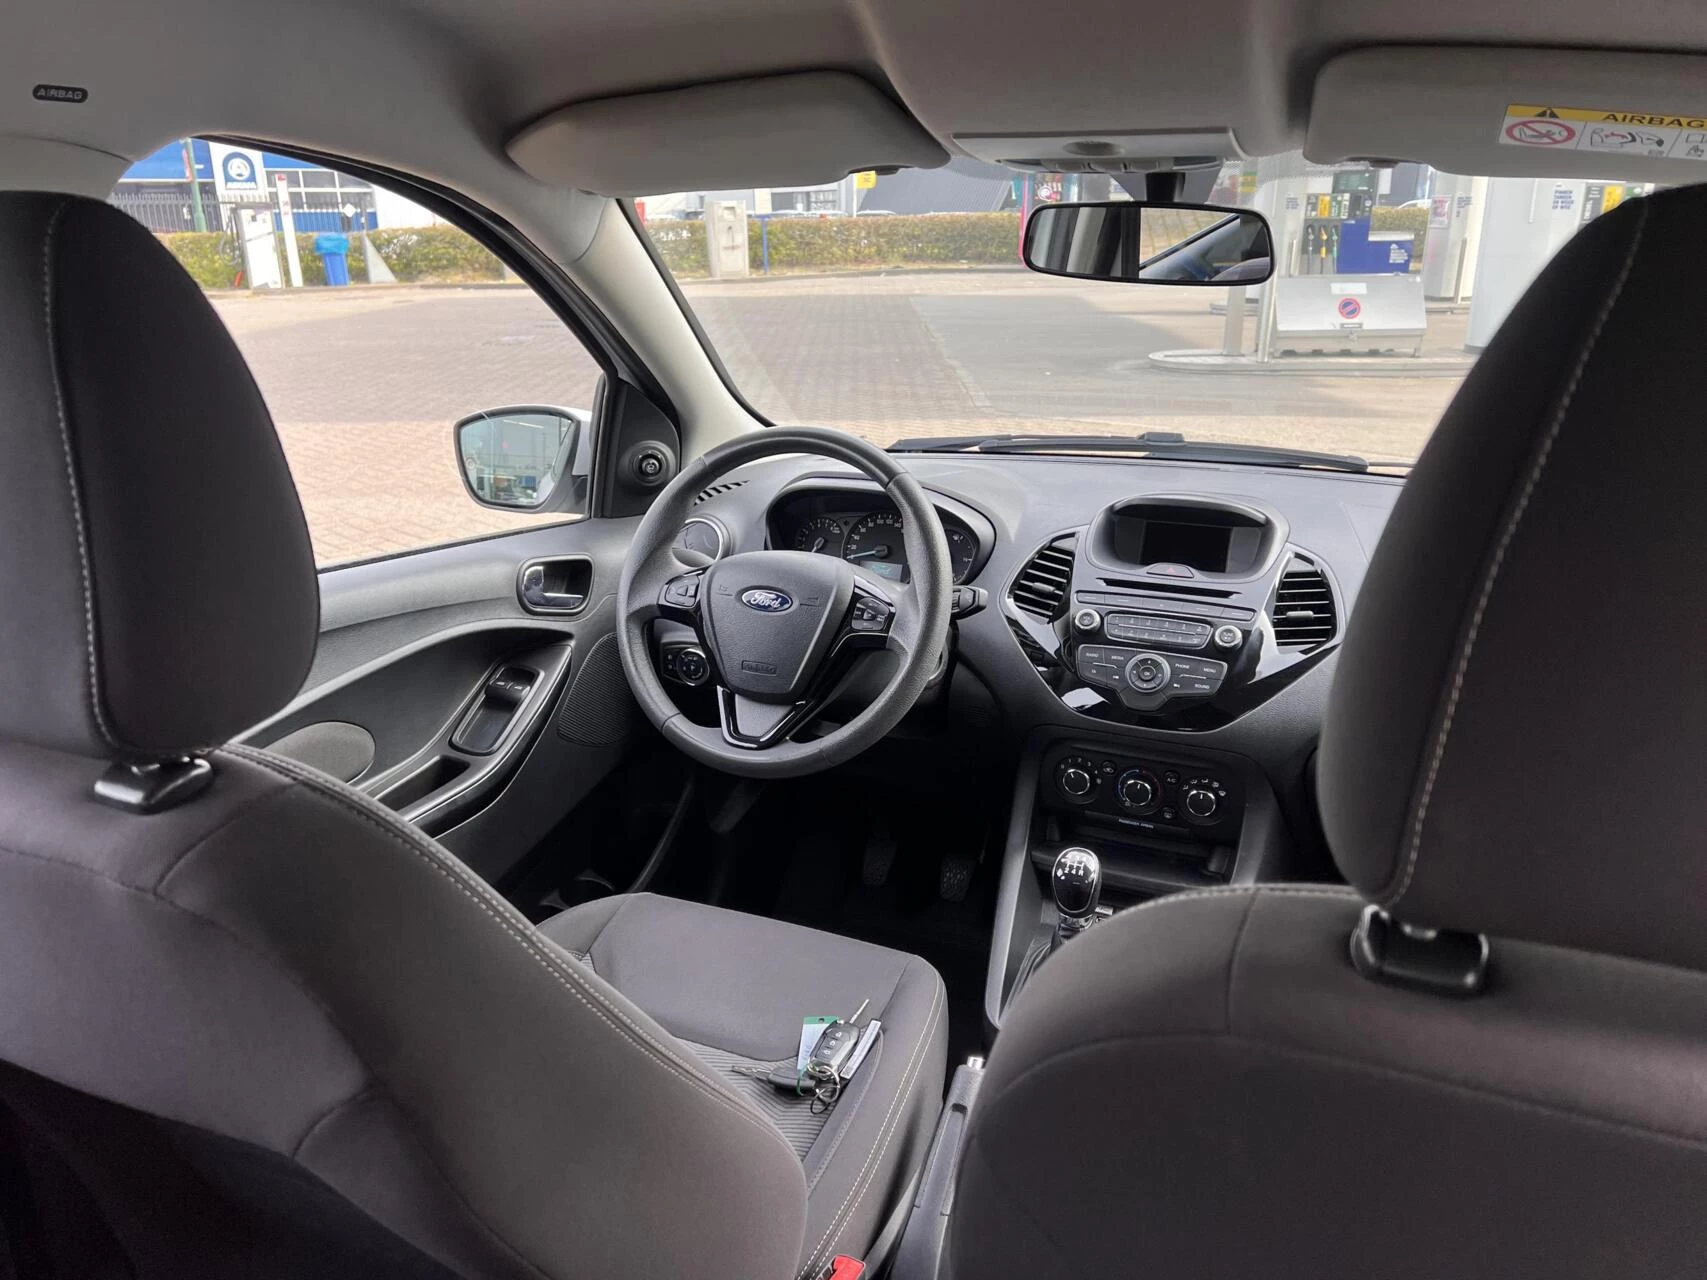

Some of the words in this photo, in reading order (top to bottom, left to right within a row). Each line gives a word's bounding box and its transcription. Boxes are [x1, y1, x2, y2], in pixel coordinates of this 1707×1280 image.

[37, 88, 82, 99] AIRBAG
[1602, 113, 1704, 128] AIRBAG
[751, 591, 781, 608] Ford
